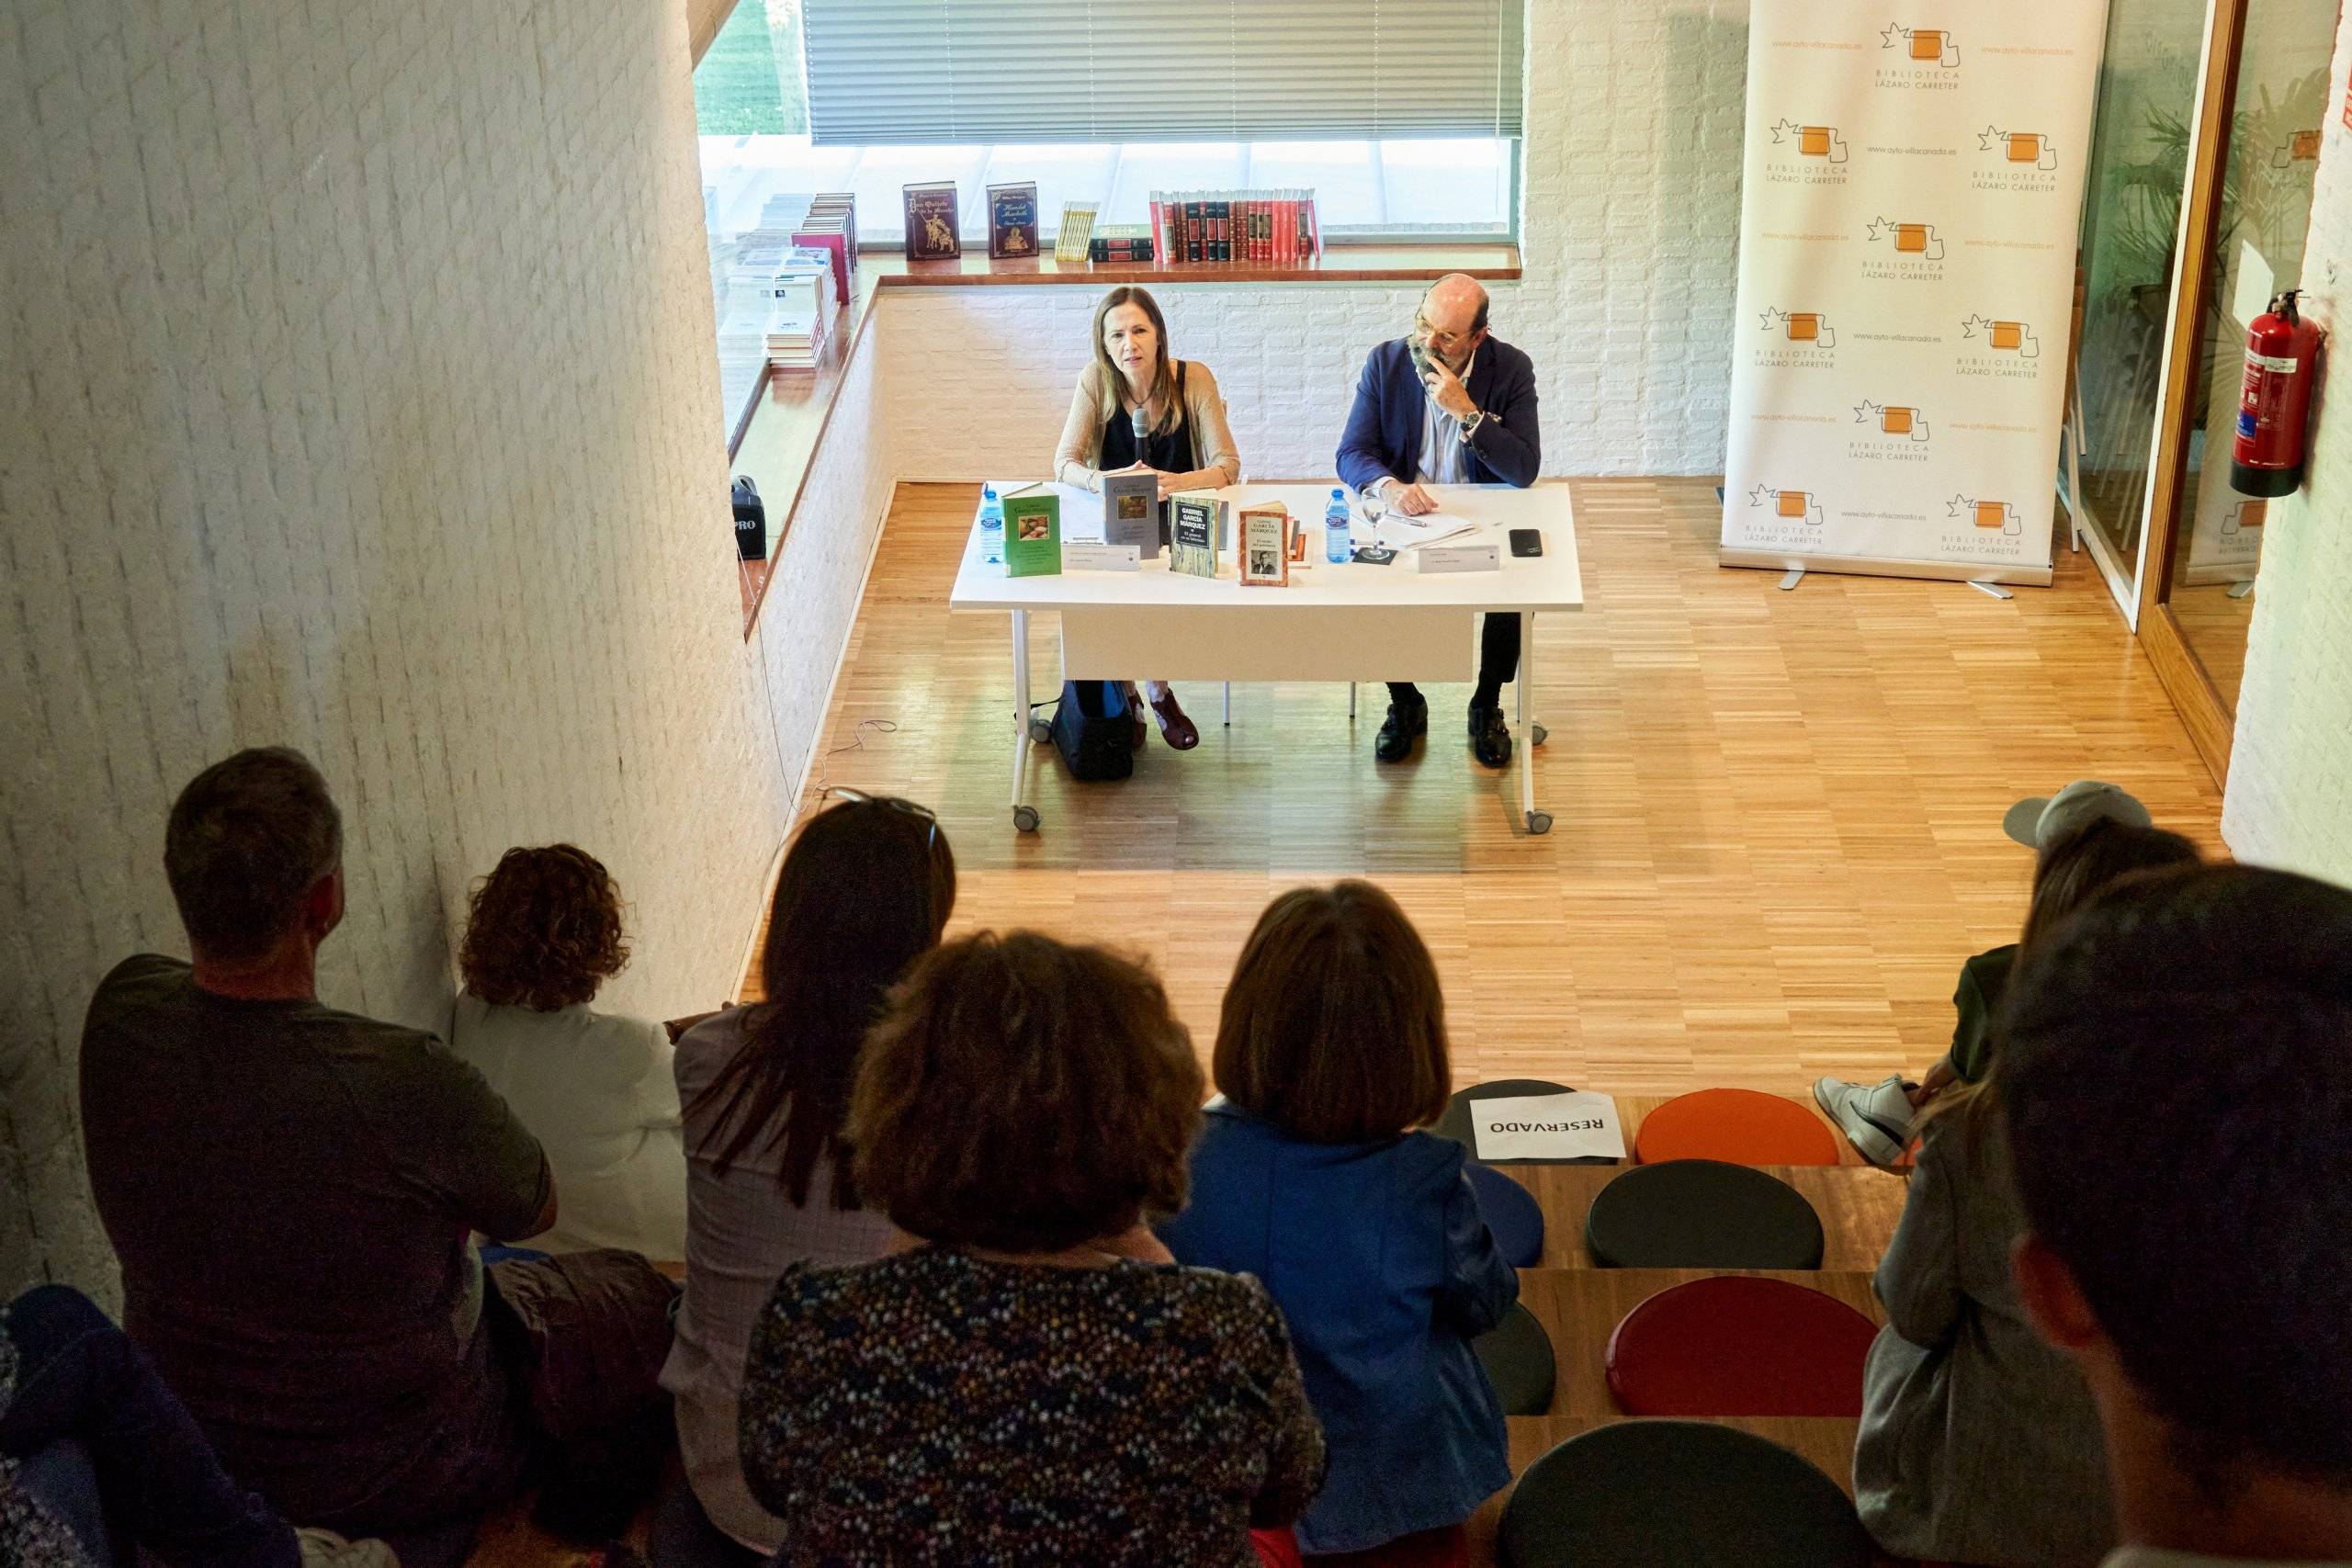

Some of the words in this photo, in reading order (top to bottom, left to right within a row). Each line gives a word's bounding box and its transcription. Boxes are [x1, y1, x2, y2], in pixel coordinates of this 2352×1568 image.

[1875, 70, 1960, 80] BIBLIOTECA
[1875, 80, 1911, 89] LÁZARO
[1915, 81, 1959, 90] CARRETER
[1766, 164, 1848, 174] BIBLIOTECA
[1766, 175, 1800, 184] LÁZARO
[1804, 175, 1848, 185] CARRETER
[1973, 171, 2056, 181] BIBLIOTECA
[1972, 182, 2007, 191] LÁZARO
[2011, 183, 2055, 192] CARRETER
[1862, 261, 1944, 270] BIBLIOTECA
[1861, 271, 1896, 279] LÁZARO
[1900, 271, 1943, 281] CARRETER
[1755, 349, 1836, 358] BIBLIOTECA
[1755, 359, 1790, 367] LÁZARO
[1792, 360, 1835, 368] CARRETER
[1957, 357, 2039, 367] BIBLIOTECA
[1956, 367, 1991, 377] LÁZARO
[1995, 368, 2038, 378] CARRETER
[1849, 442, 1929, 451] BIBLIOTECA
[1849, 451, 1883, 460] LÁZARO
[1886, 452, 1928, 461] CARRETER
[1182, 508, 1204, 516] GABRIEL
[1745, 525, 1823, 535] BIBLIOTECA
[1744, 535, 1779, 543] LÁZARO
[1781, 536, 1823, 544] CARRETER
[1941, 536, 2020, 545] BIBLIOTECA
[1941, 546, 1974, 554] LÁZARO
[1978, 547, 2020, 555] CARRETER
[1490, 1118, 1604, 1133] RESERVADO
